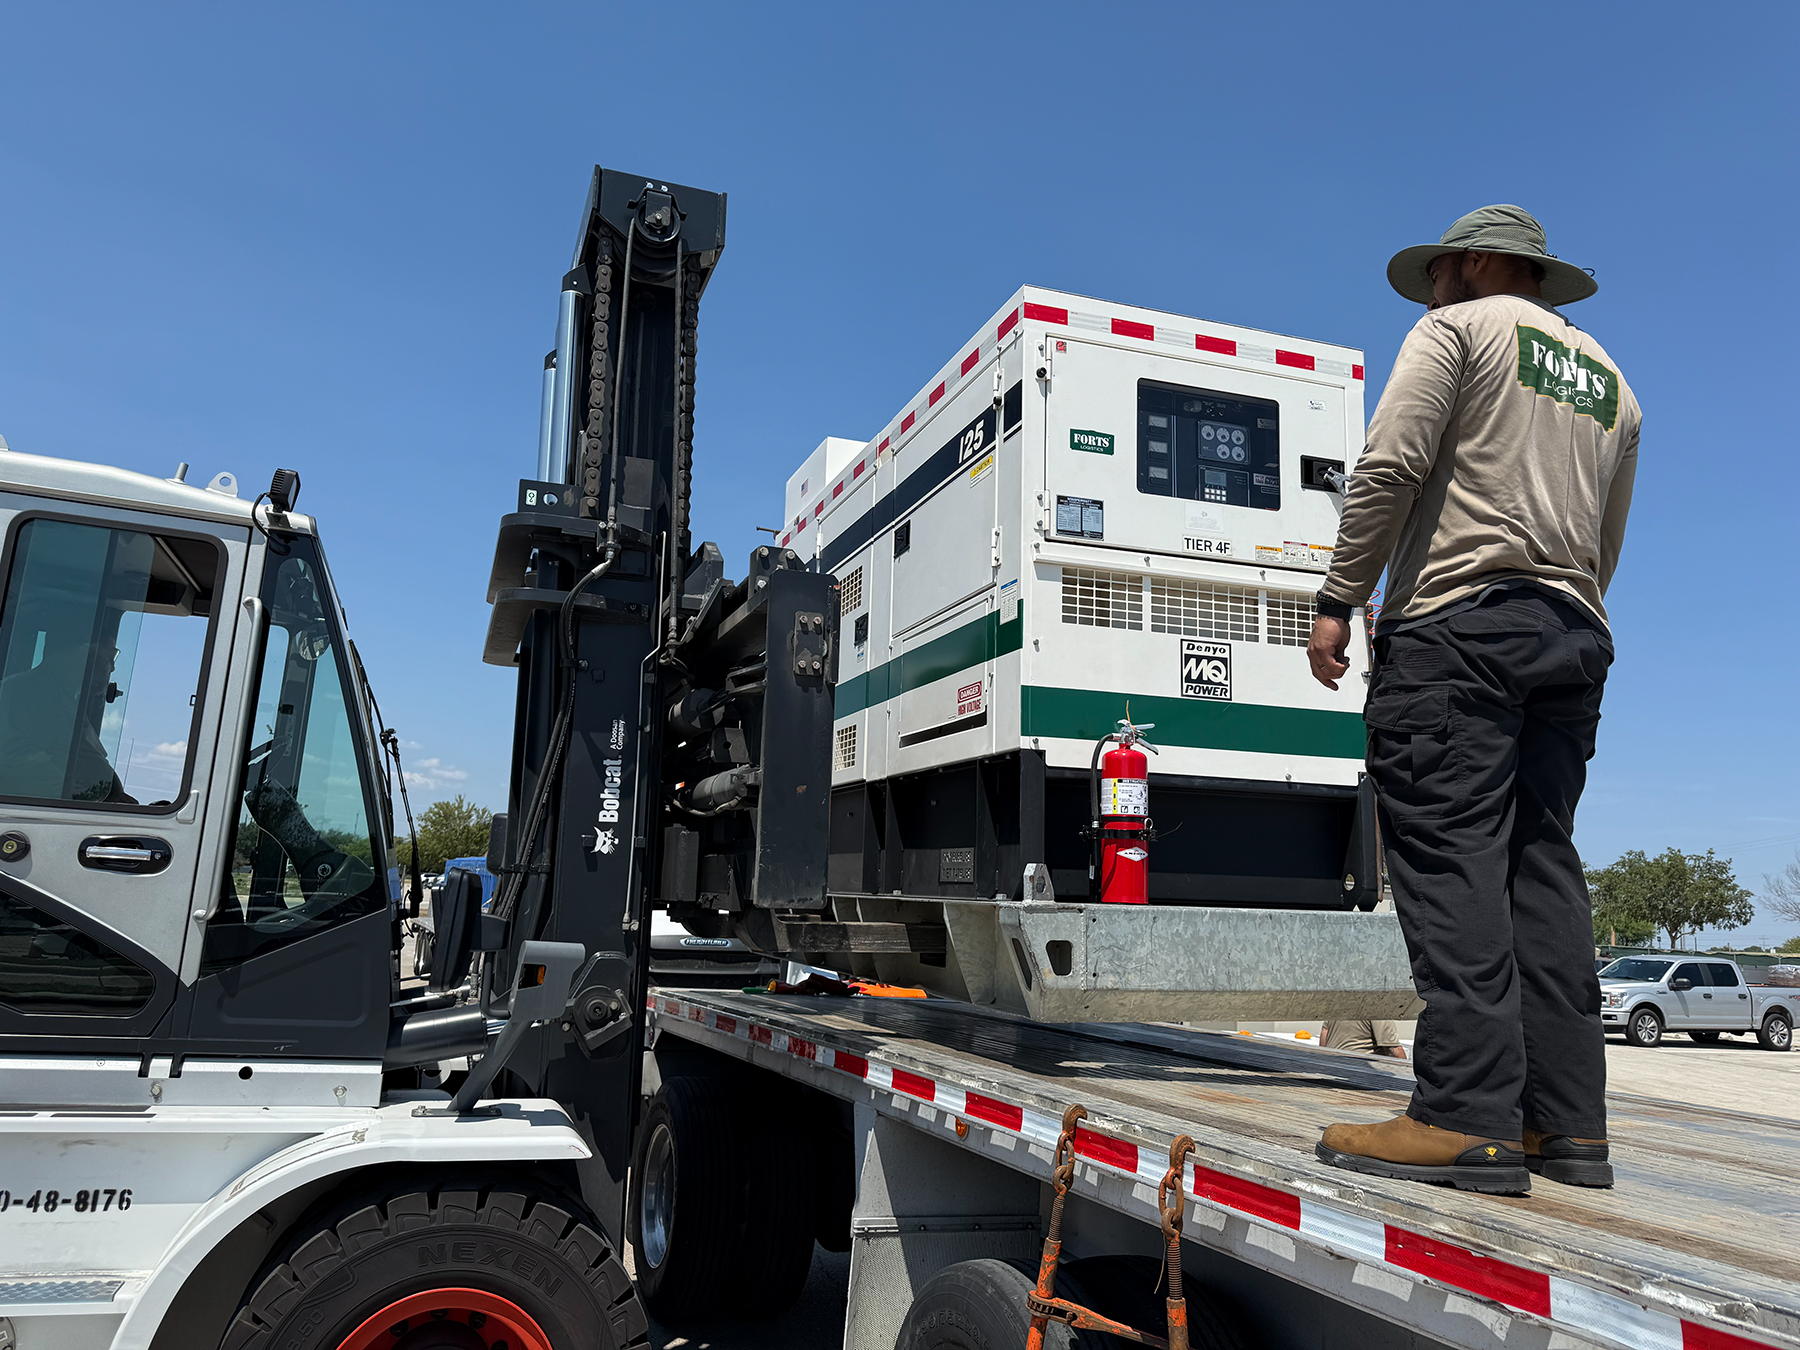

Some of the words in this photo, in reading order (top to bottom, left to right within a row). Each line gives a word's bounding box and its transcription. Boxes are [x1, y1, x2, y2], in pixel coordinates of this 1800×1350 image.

[1531, 340, 1606, 400] FORTS
[1544, 378, 1594, 408] LOGISCS
[958, 419, 985, 464] 125
[1073, 433, 1110, 448] FORTS
[1184, 537, 1213, 553] TIER
[1215, 541, 1231, 554] 4F
[1186, 643, 1227, 655] Denyo
[1184, 657, 1228, 685] MQ
[1185, 684, 1228, 697] POWER
[610, 719, 618, 743] Doosan
[616, 719, 626, 750] Company
[599, 758, 622, 823] Bobcat
[417, 1240, 564, 1299] NEXEN
